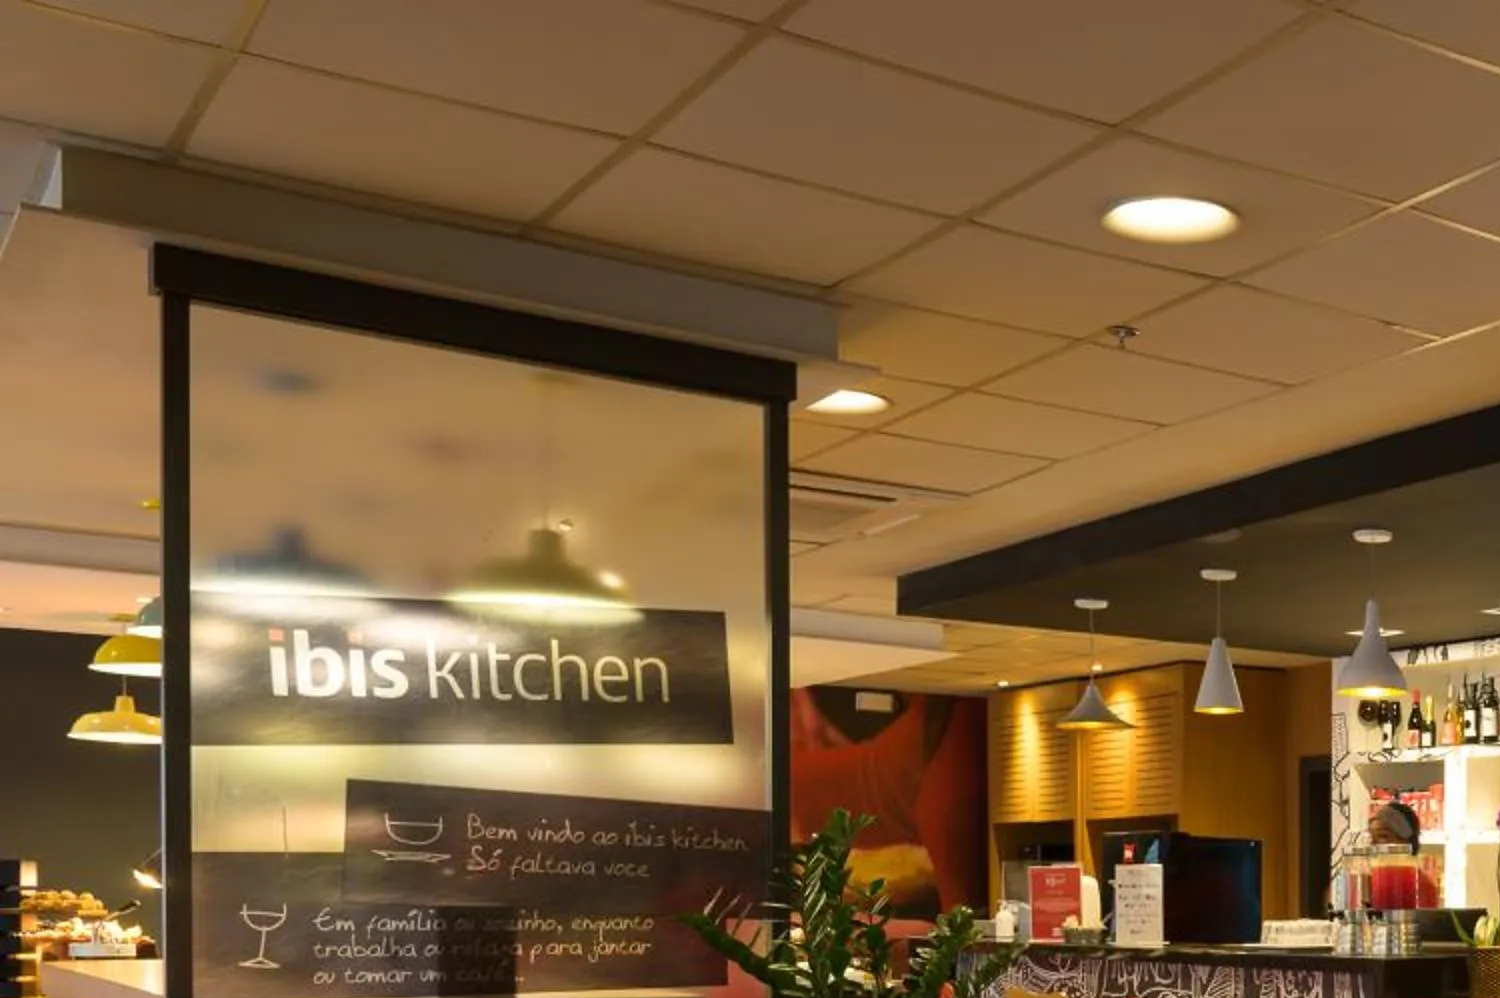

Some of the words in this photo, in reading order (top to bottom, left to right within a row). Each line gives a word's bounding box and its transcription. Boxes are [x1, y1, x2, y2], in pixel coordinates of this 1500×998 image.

[268, 628, 409, 698] ibis
[424, 632, 671, 703] kitchen
[466, 812, 518, 841] Bem
[527, 819, 586, 845] vindo
[591, 831, 620, 846] ao
[624, 820, 666, 848] ibis
[464, 844, 503, 872] Só
[509, 853, 596, 881] faltava
[312, 907, 356, 932] Em
[571, 915, 655, 942] enquanto
[312, 932, 418, 960] trabalha
[529, 941, 583, 965] para
[587, 937, 652, 963] jantar
[313, 970, 336, 985] ou
[344, 969, 413, 985] tomar
[418, 970, 447, 984] um
